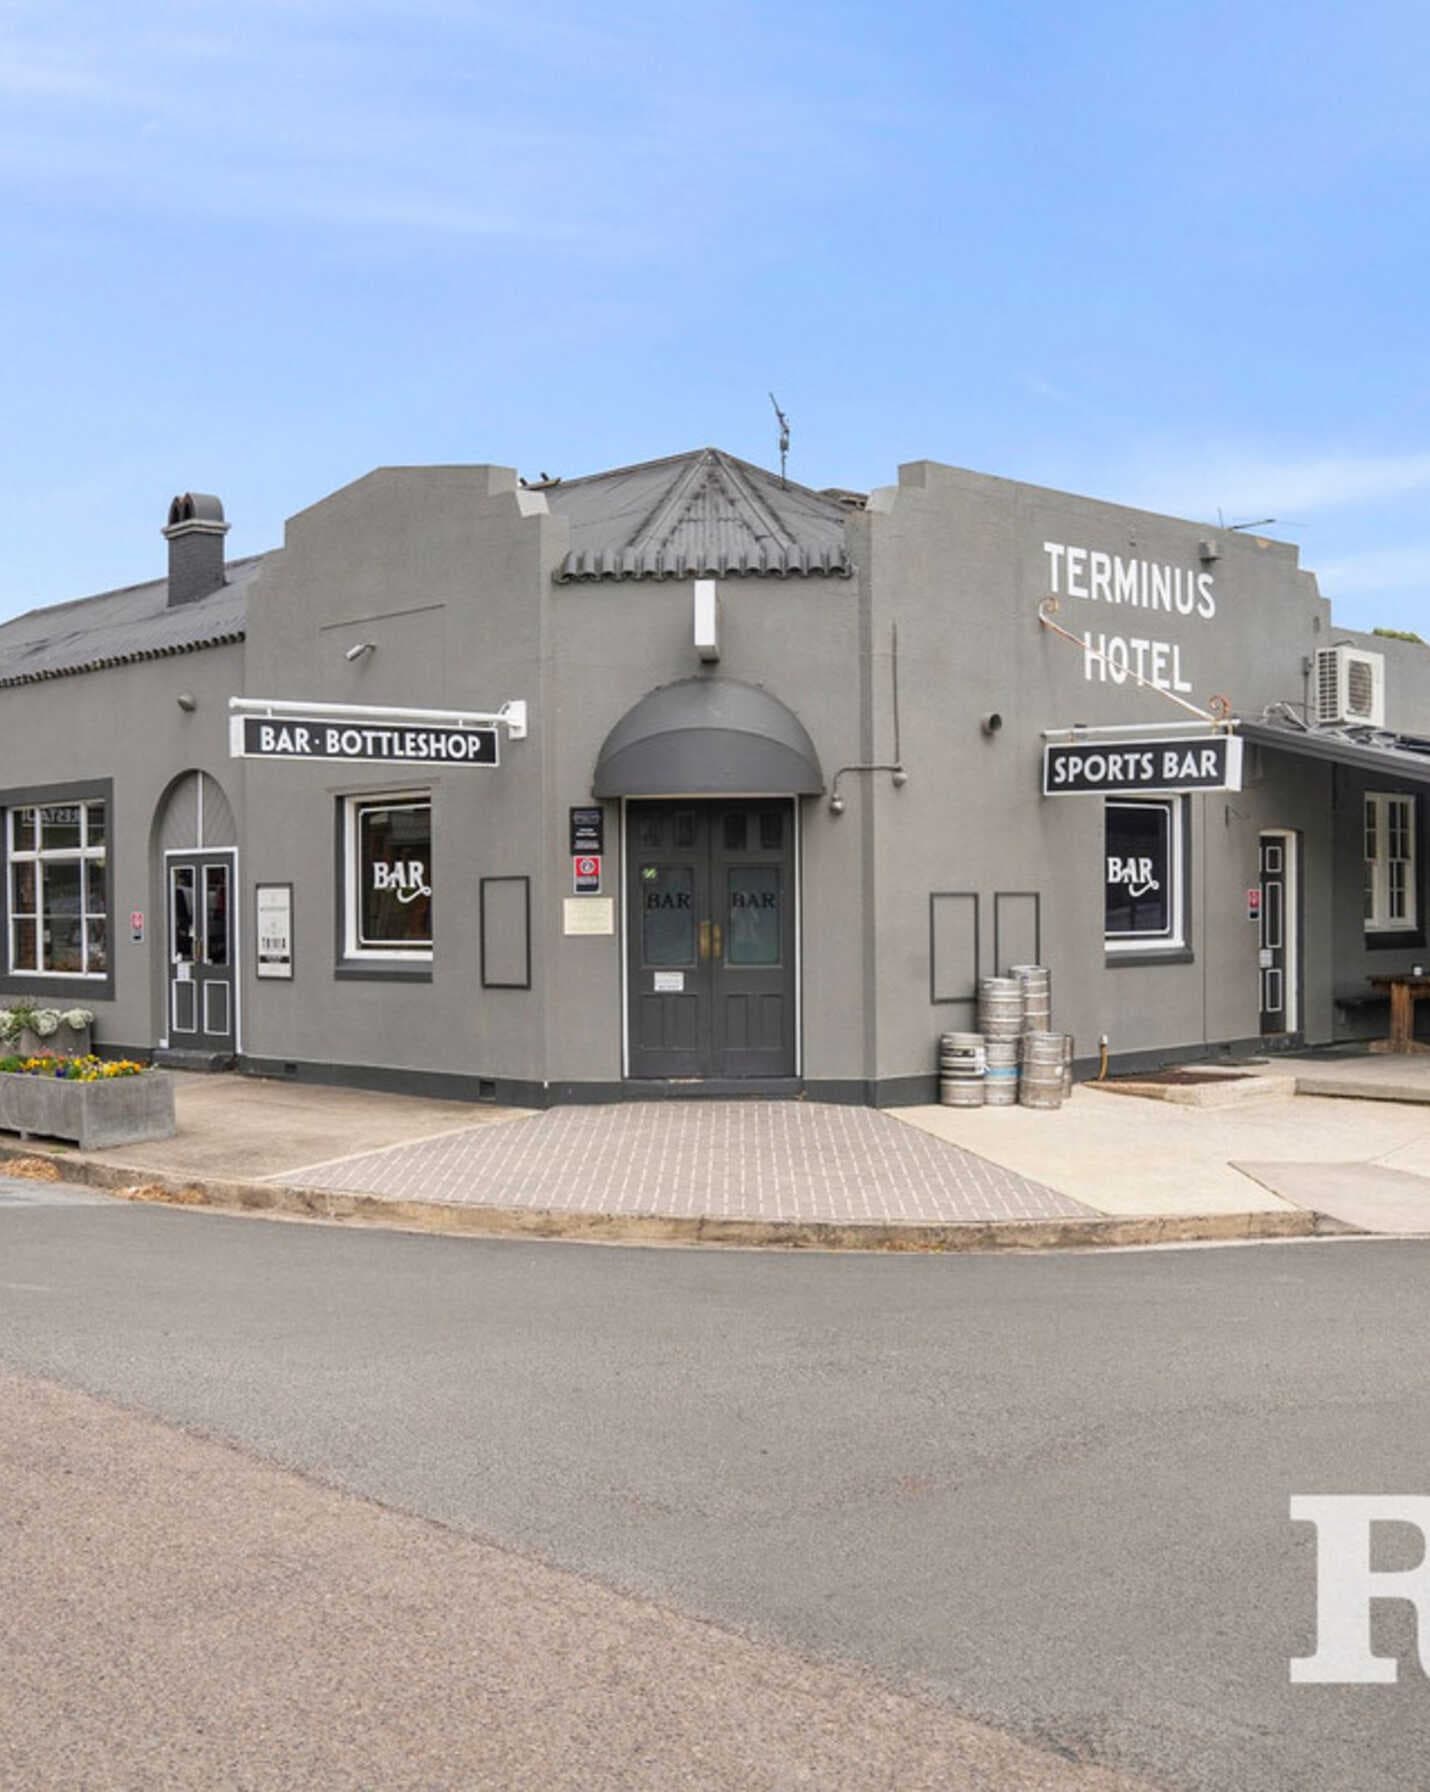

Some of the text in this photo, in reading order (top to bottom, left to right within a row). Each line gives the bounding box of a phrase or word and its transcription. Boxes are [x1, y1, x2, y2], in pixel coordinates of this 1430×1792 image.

[1043, 541, 1216, 619] TERMINUS
[1083, 631, 1193, 693] HOTEL
[260, 725, 482, 759] BAR BOTTLESHOP
[1053, 749, 1219, 784] SPORTS BAR
[373, 861, 432, 904] BAR
[1107, 857, 1160, 897] BAR
[647, 891, 692, 910] BAR
[732, 891, 777, 910] BAR
